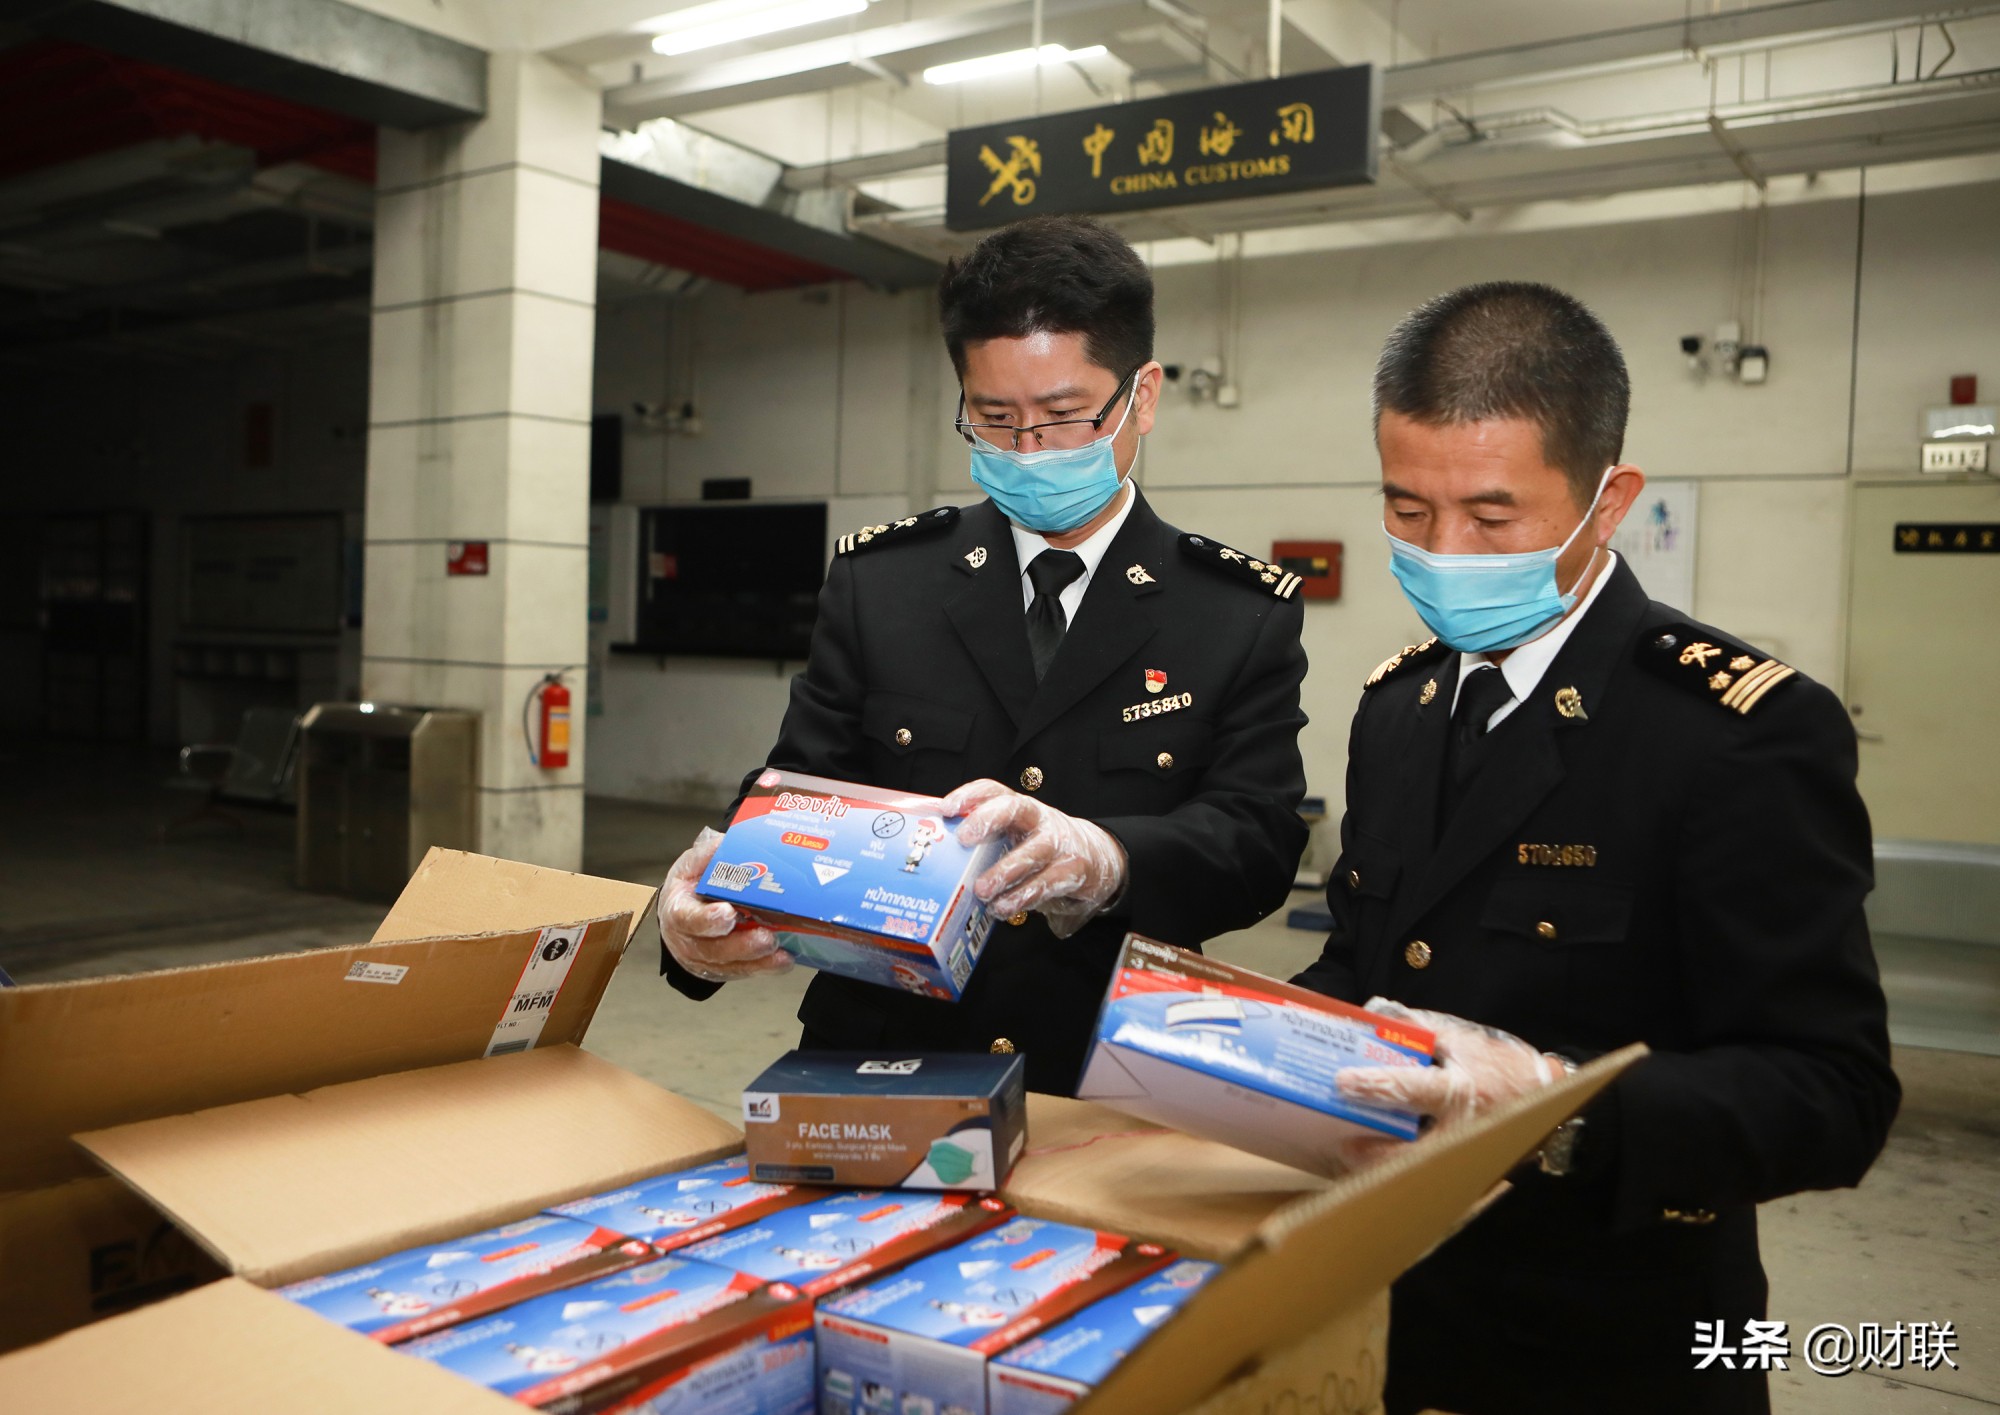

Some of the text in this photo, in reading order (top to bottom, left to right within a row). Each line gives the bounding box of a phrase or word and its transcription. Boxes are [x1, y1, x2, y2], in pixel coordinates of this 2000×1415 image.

[1110, 155, 1291, 195] CHINA CUSTOMS
[1122, 692, 1192, 722] 5735840
[774, 792, 851, 822] กรองฝุ่น
[785, 832, 801, 845] 3.0
[513, 994, 554, 1013] MFM
[798, 1122, 892, 1141] FACE MASK
